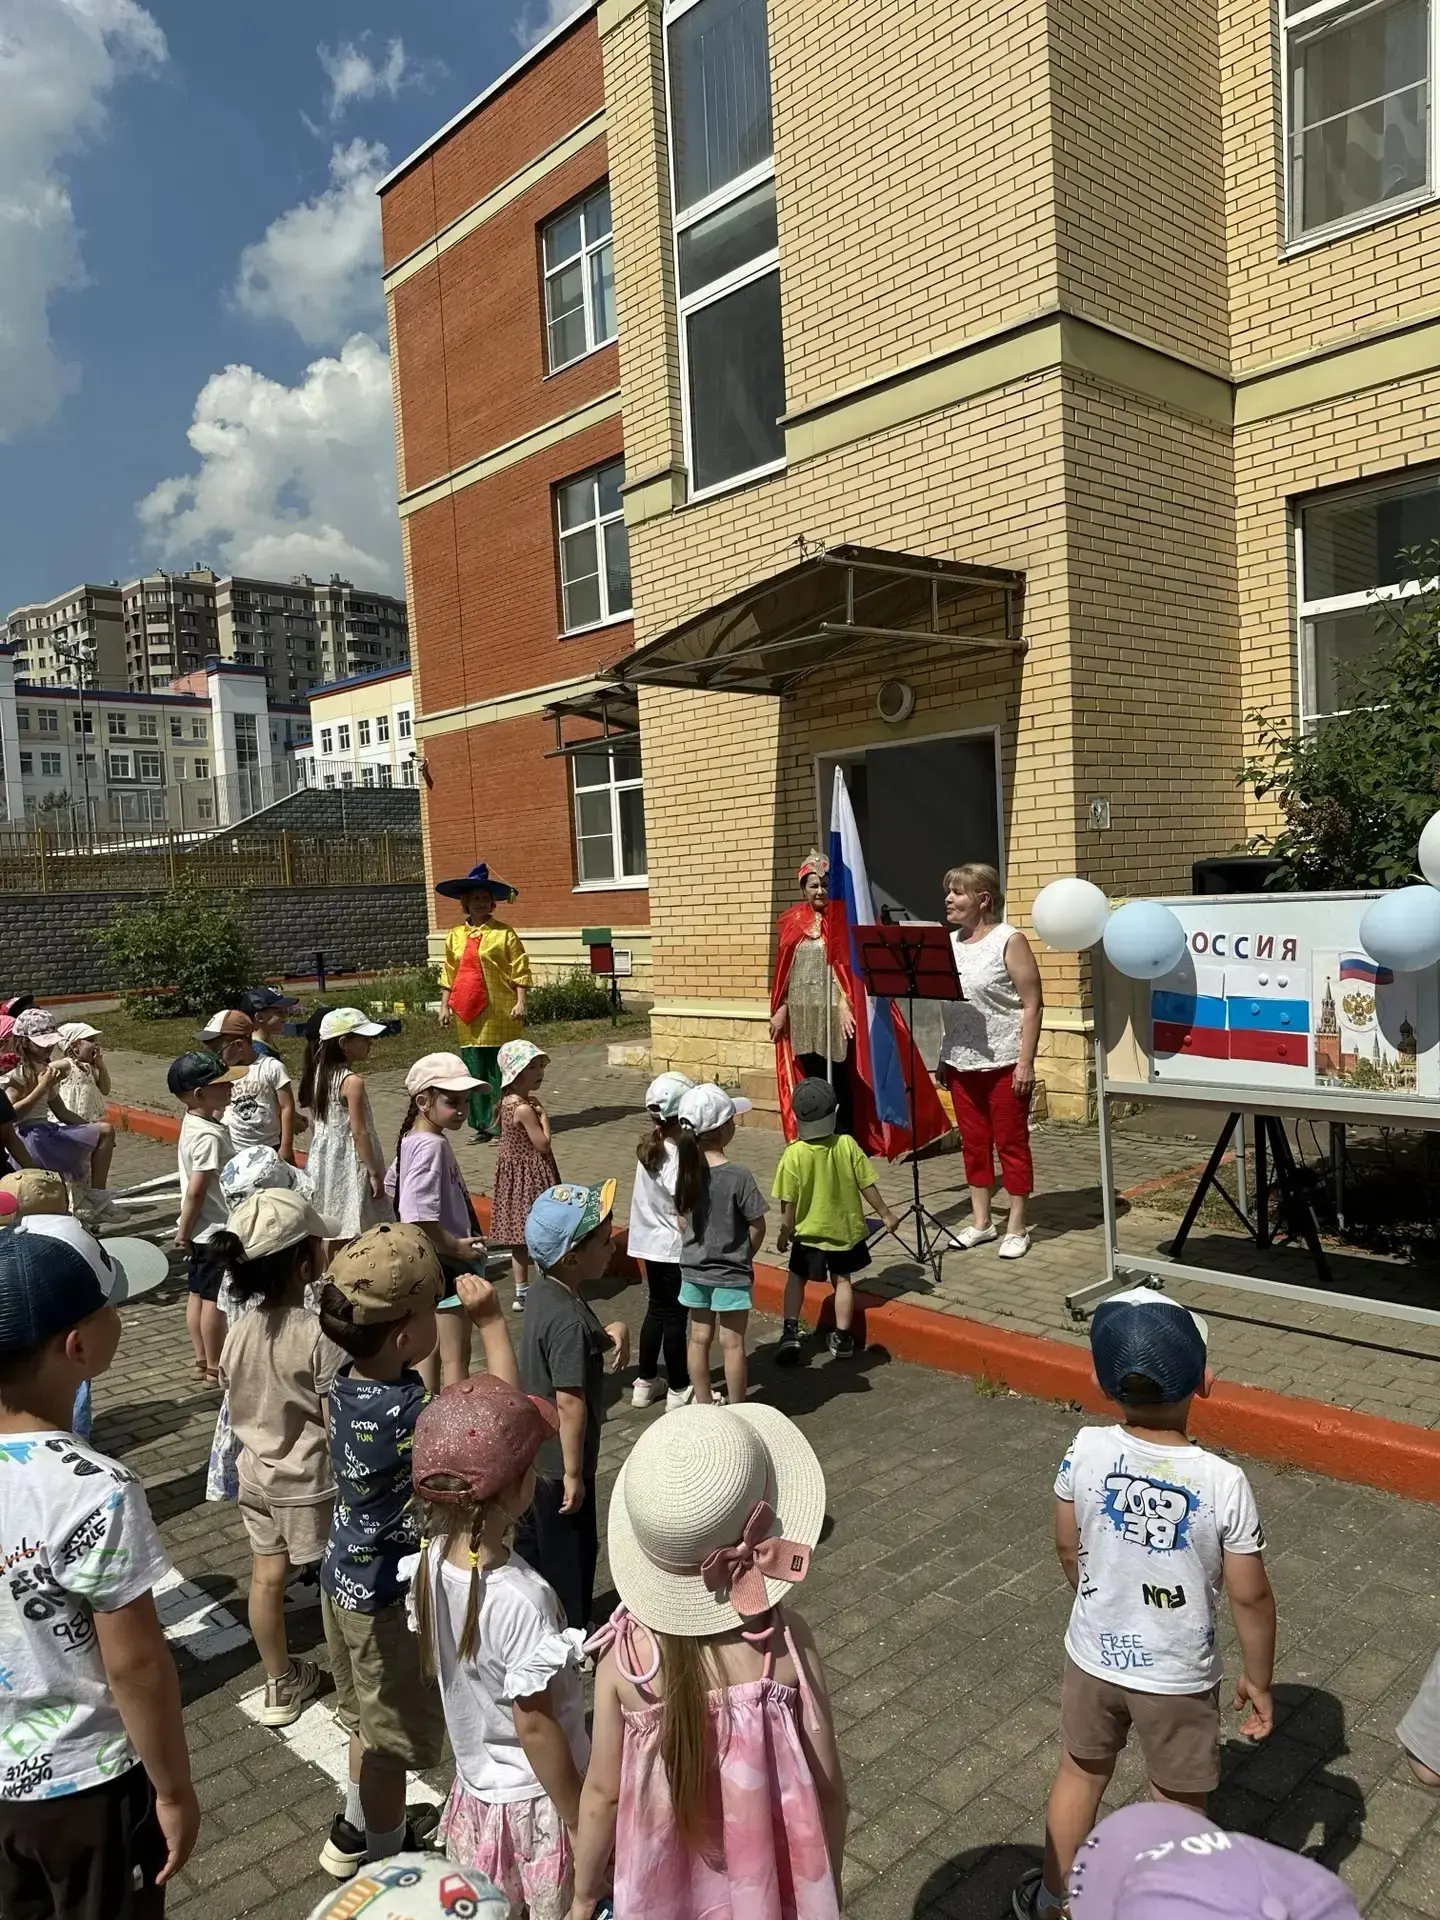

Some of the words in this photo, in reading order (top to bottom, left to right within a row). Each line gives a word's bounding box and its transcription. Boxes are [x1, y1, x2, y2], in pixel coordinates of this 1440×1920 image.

[1184, 931, 1298, 961] ОССИЯ
[356, 1432, 374, 1443] FUN
[64, 1517, 107, 1565] STYLE
[1123, 1514, 1178, 1550] BE
[334, 1567, 376, 1600] ENJOY
[1142, 1583, 1187, 1609] FUN
[52, 1611, 91, 1644] 98
[1099, 1633, 1144, 1650] FREE
[1100, 1649, 1155, 1670] STYLE
